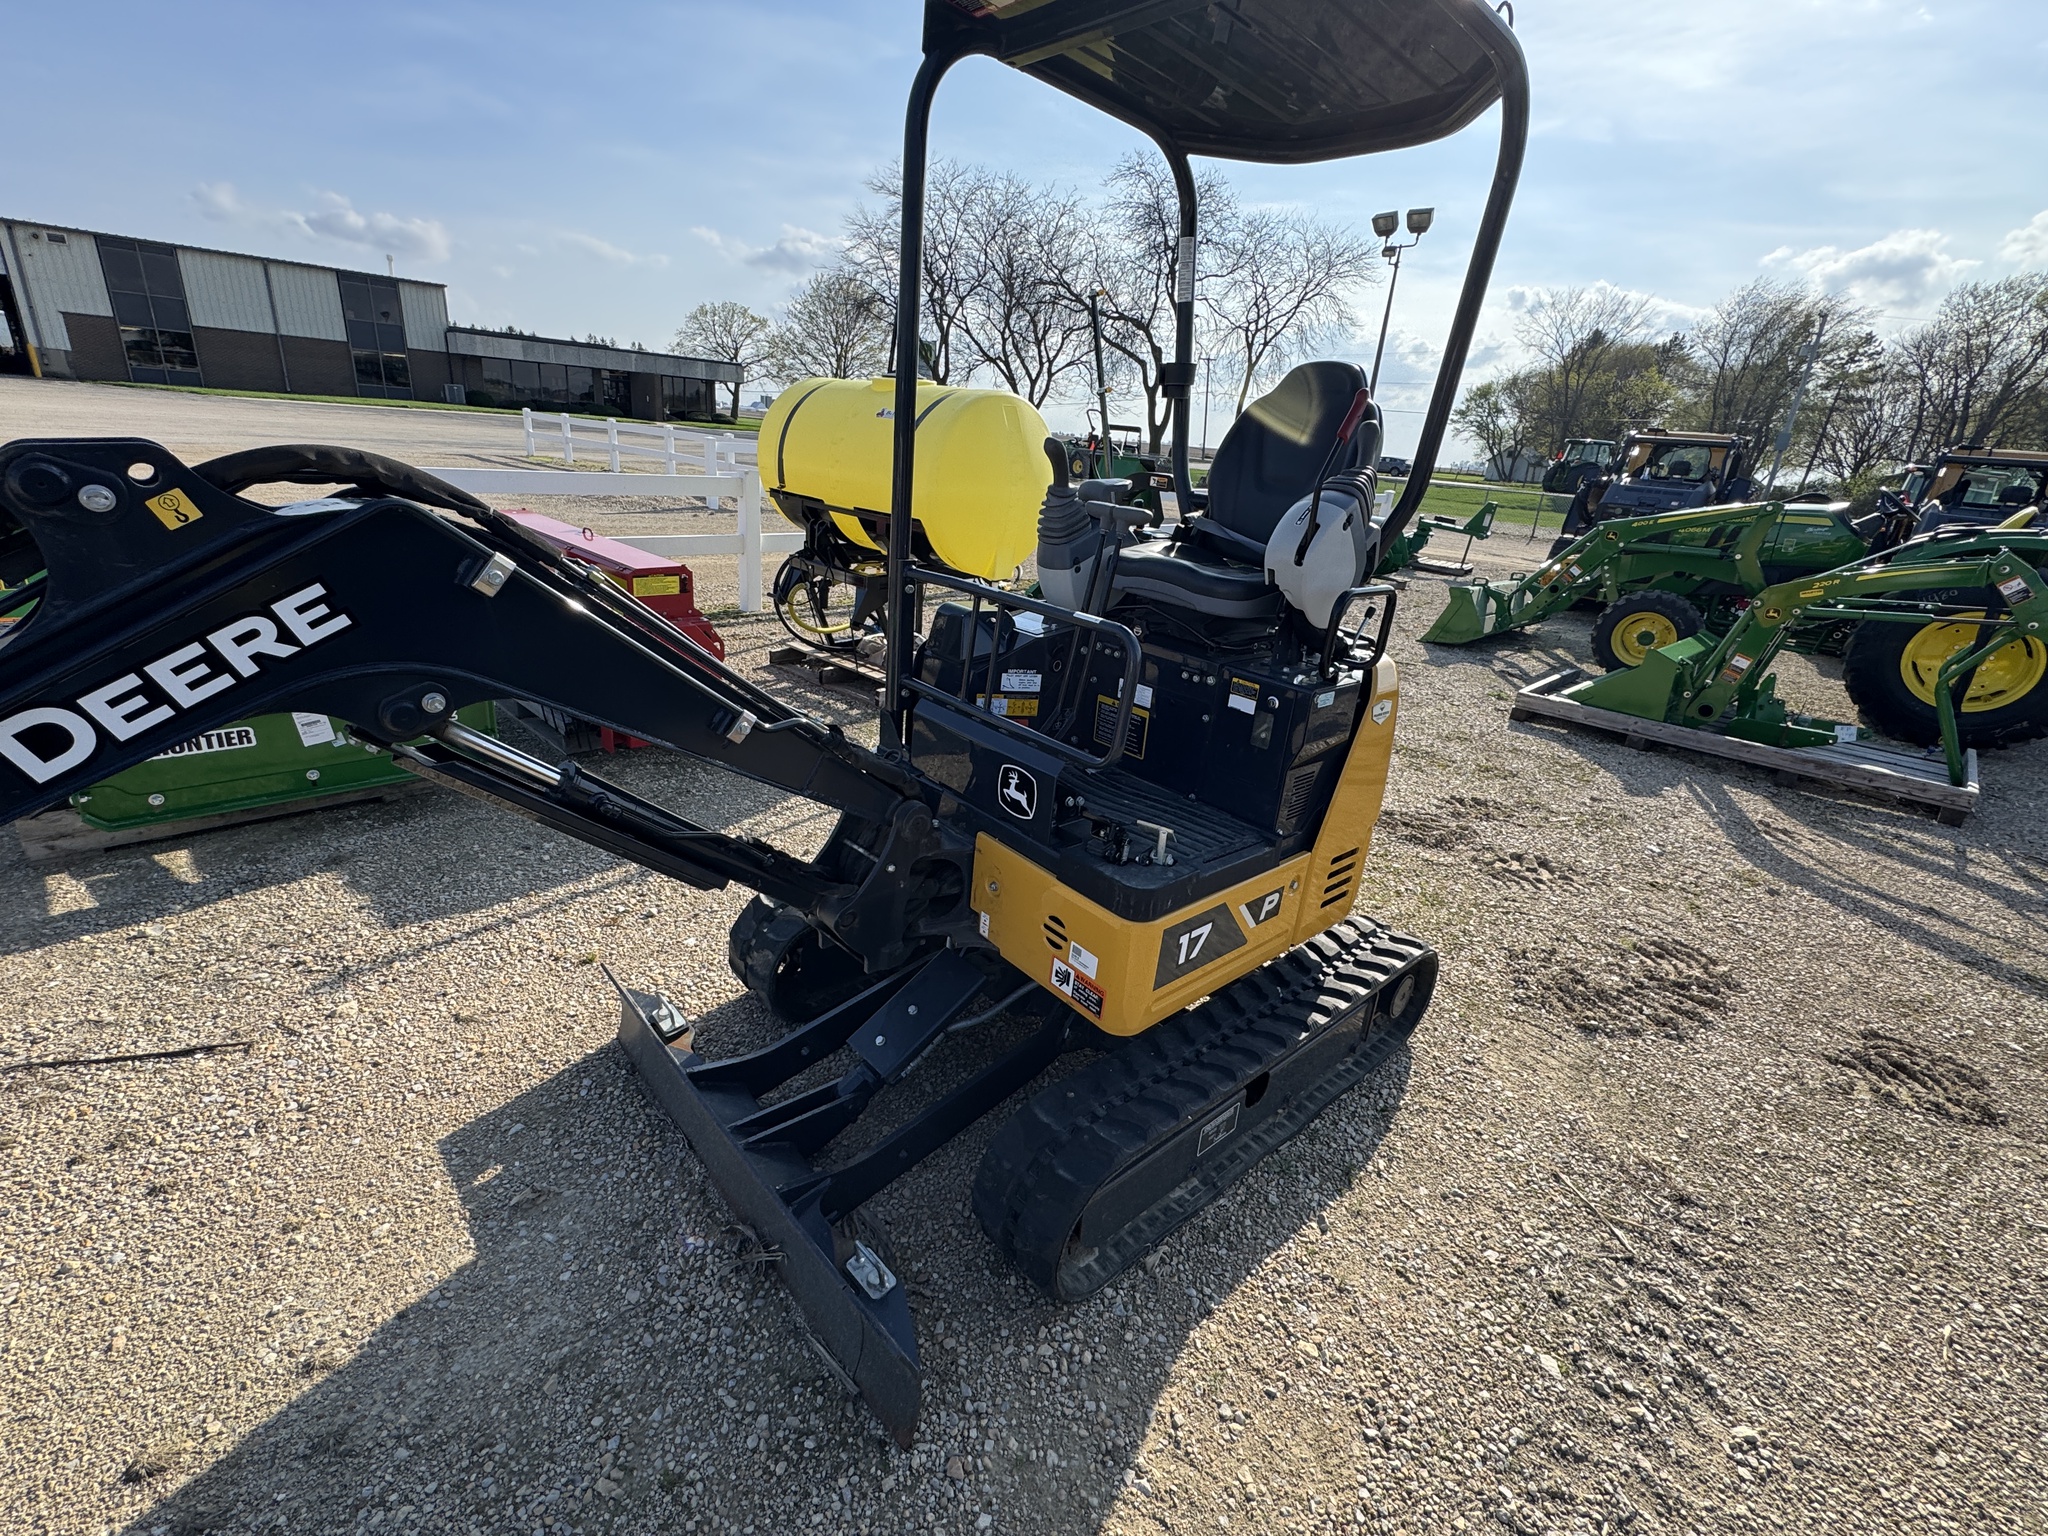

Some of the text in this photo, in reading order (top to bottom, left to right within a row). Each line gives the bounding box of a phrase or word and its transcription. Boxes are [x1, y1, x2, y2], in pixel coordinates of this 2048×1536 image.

[0, 583, 352, 784] DEERE
[1178, 892, 1280, 965] 17 P
